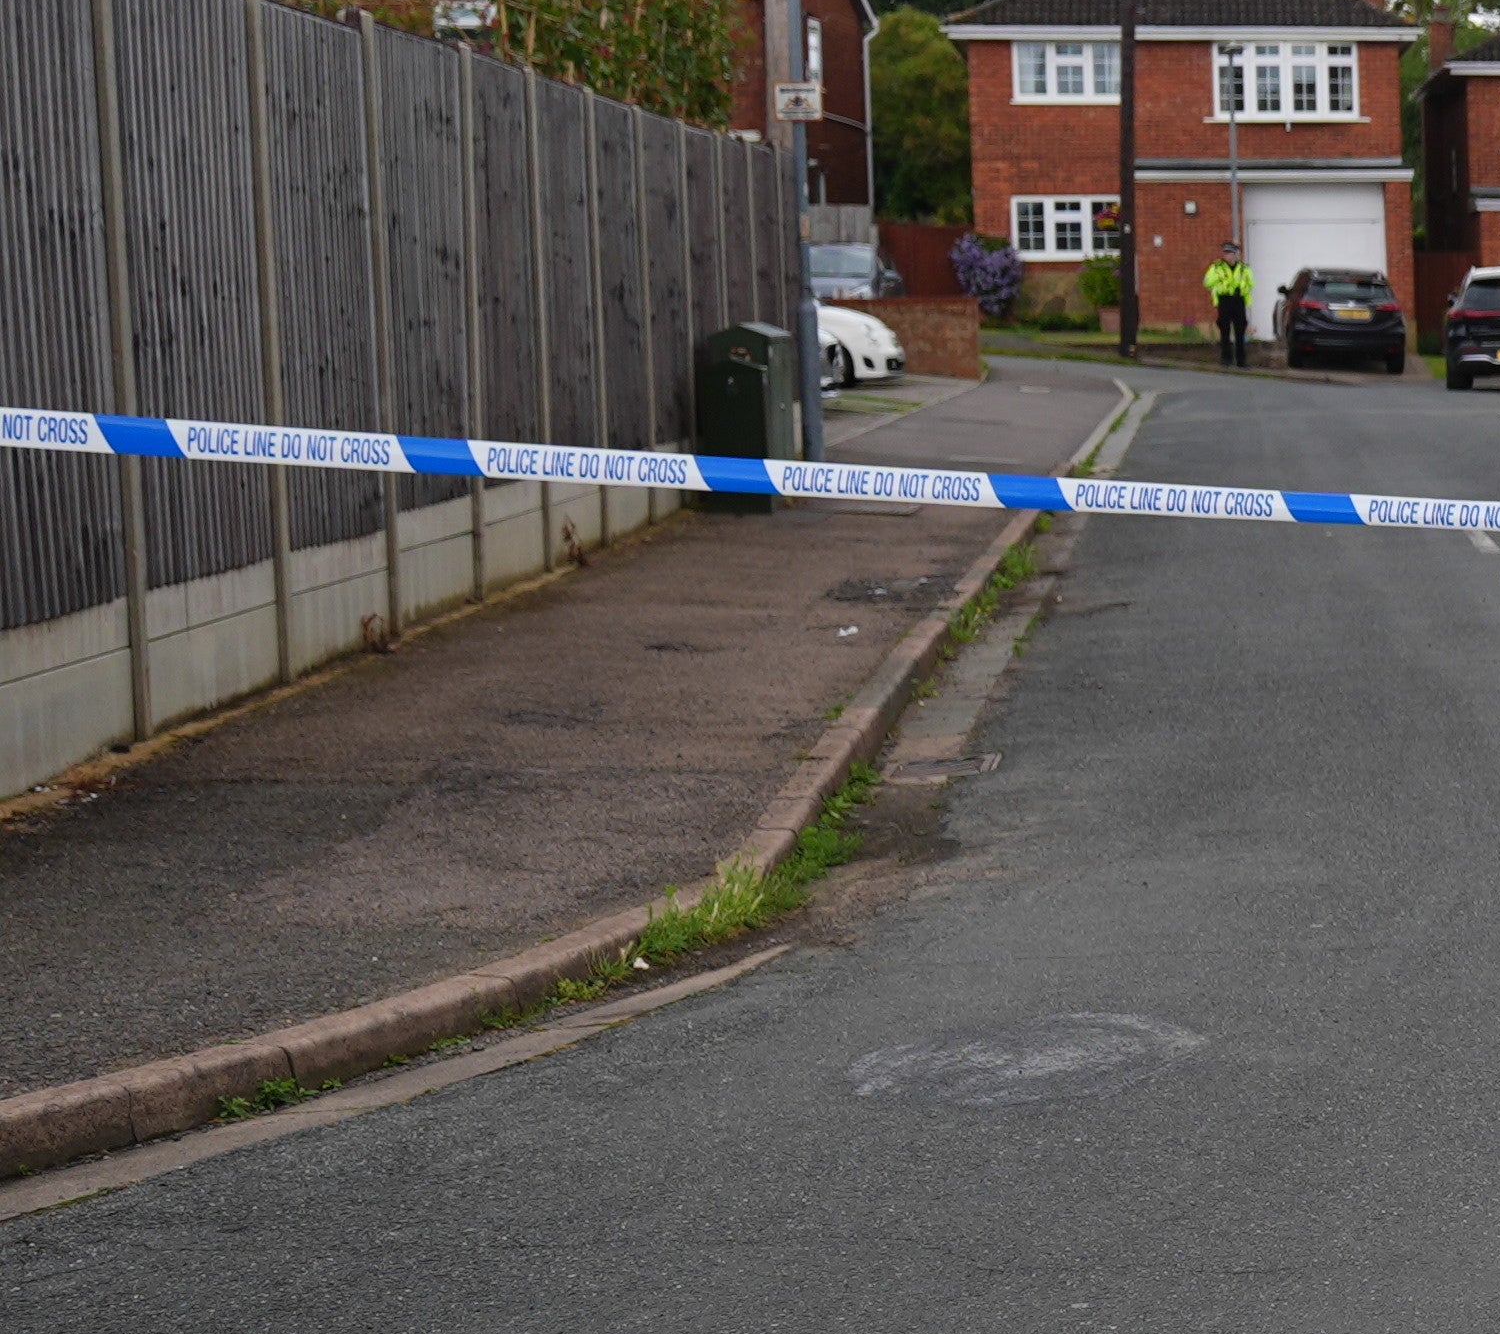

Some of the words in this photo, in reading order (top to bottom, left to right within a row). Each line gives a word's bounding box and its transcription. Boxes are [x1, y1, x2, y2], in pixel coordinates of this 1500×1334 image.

[1, 413, 33, 441] NOT
[37, 415, 88, 446] CROSS
[187, 426, 239, 456] POLICE
[243, 431, 276, 459] LINE
[280, 432, 301, 460] DO
[306, 434, 337, 462] NOT
[340, 436, 390, 466] CROSS
[486, 447, 538, 476] POLICE
[542, 451, 575, 478] LINE
[578, 453, 599, 480] DO
[603, 454, 634, 481] NOT
[637, 456, 687, 485] CROSS
[782, 466, 833, 494] POLICE
[837, 469, 869, 496] LINE
[873, 471, 894, 498] DO
[897, 473, 928, 499] NOT
[931, 475, 980, 502] CROSS
[1075, 483, 1126, 510] POLICE
[1129, 486, 1162, 512] LINE
[1166, 488, 1187, 513] DO
[1190, 490, 1221, 515] NOT
[1224, 491, 1273, 518] CROSS
[1368, 499, 1419, 525] POLICE
[1422, 502, 1455, 527] LINE
[1459, 504, 1479, 529] DO
